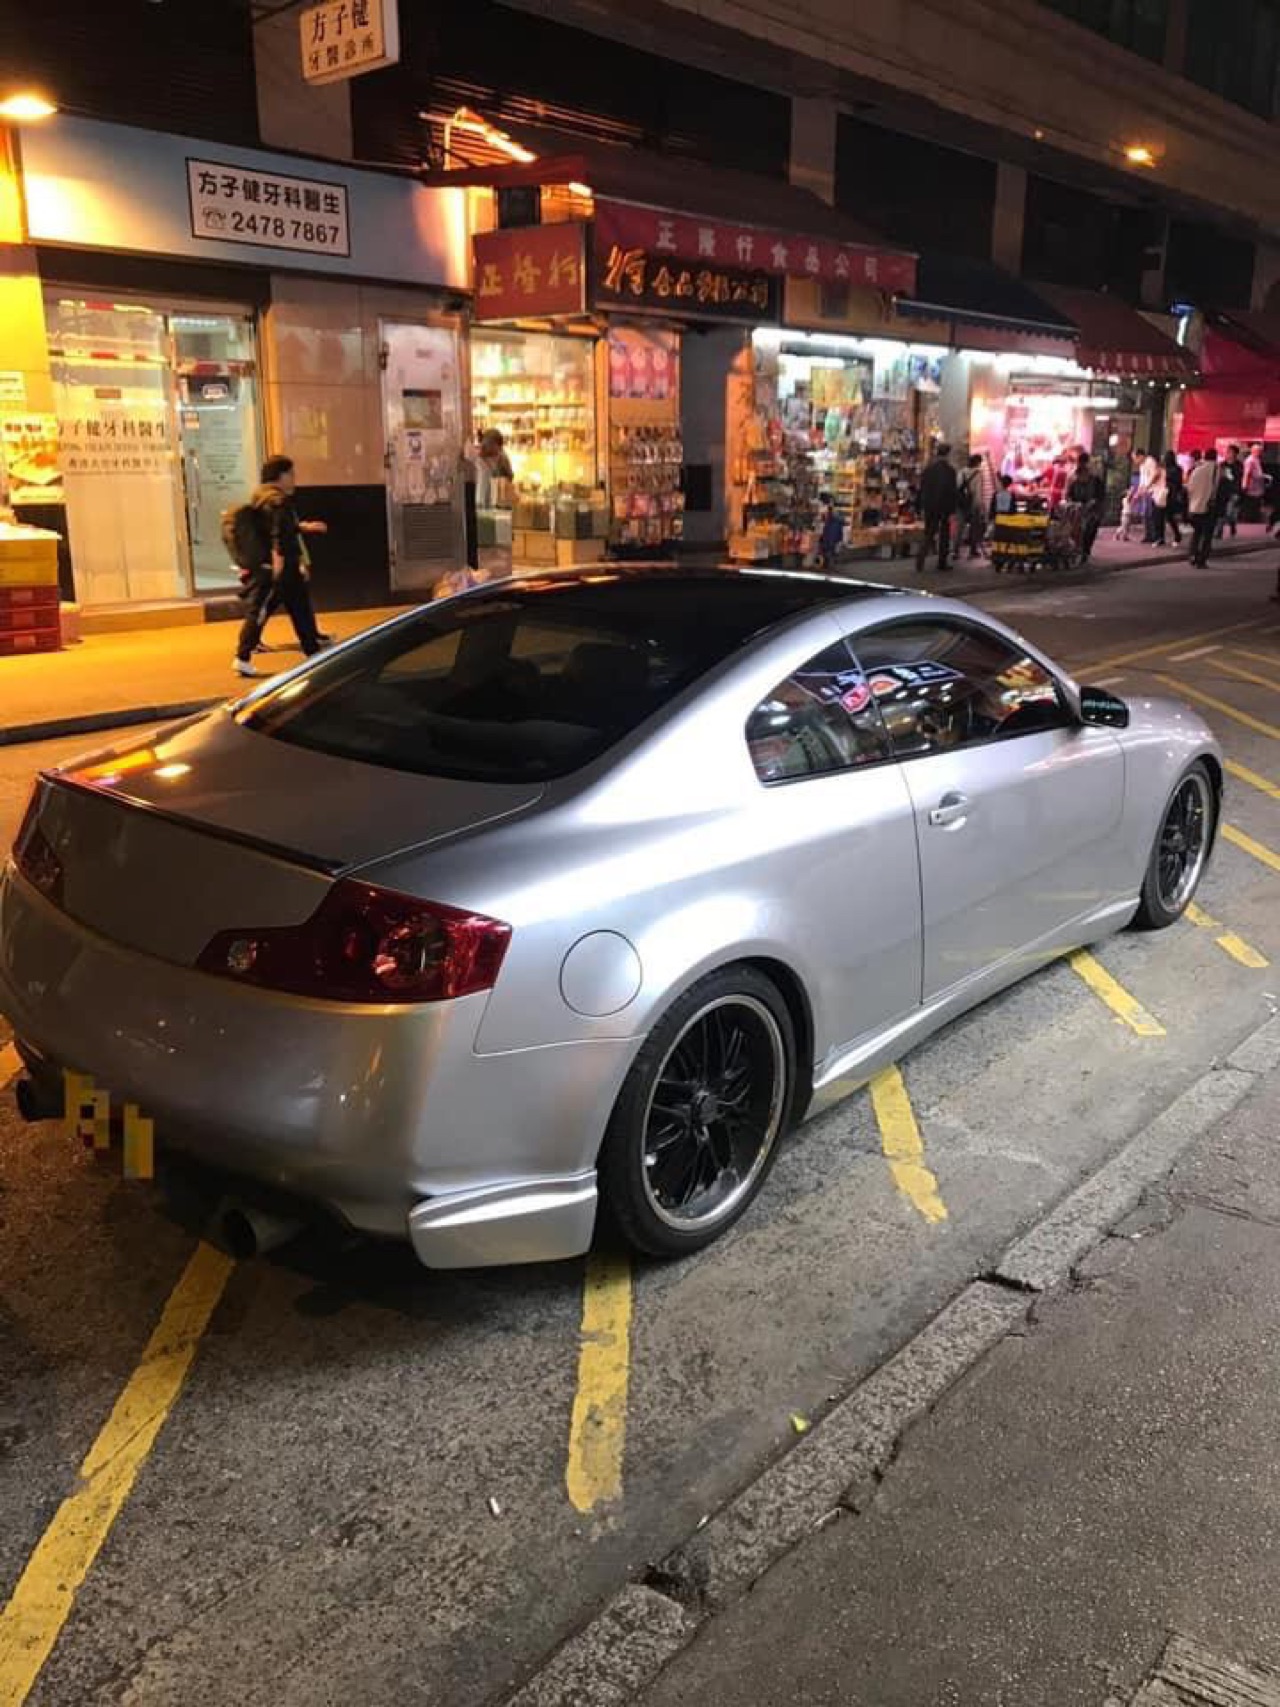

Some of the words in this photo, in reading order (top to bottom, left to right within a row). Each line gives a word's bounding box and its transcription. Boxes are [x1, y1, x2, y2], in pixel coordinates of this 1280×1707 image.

[198, 170, 341, 215] 方子健牙科醫生
[231, 211, 285, 238] 2478
[290, 219, 340, 244] 7867
[655, 220, 879, 282] 正隆行食品公司
